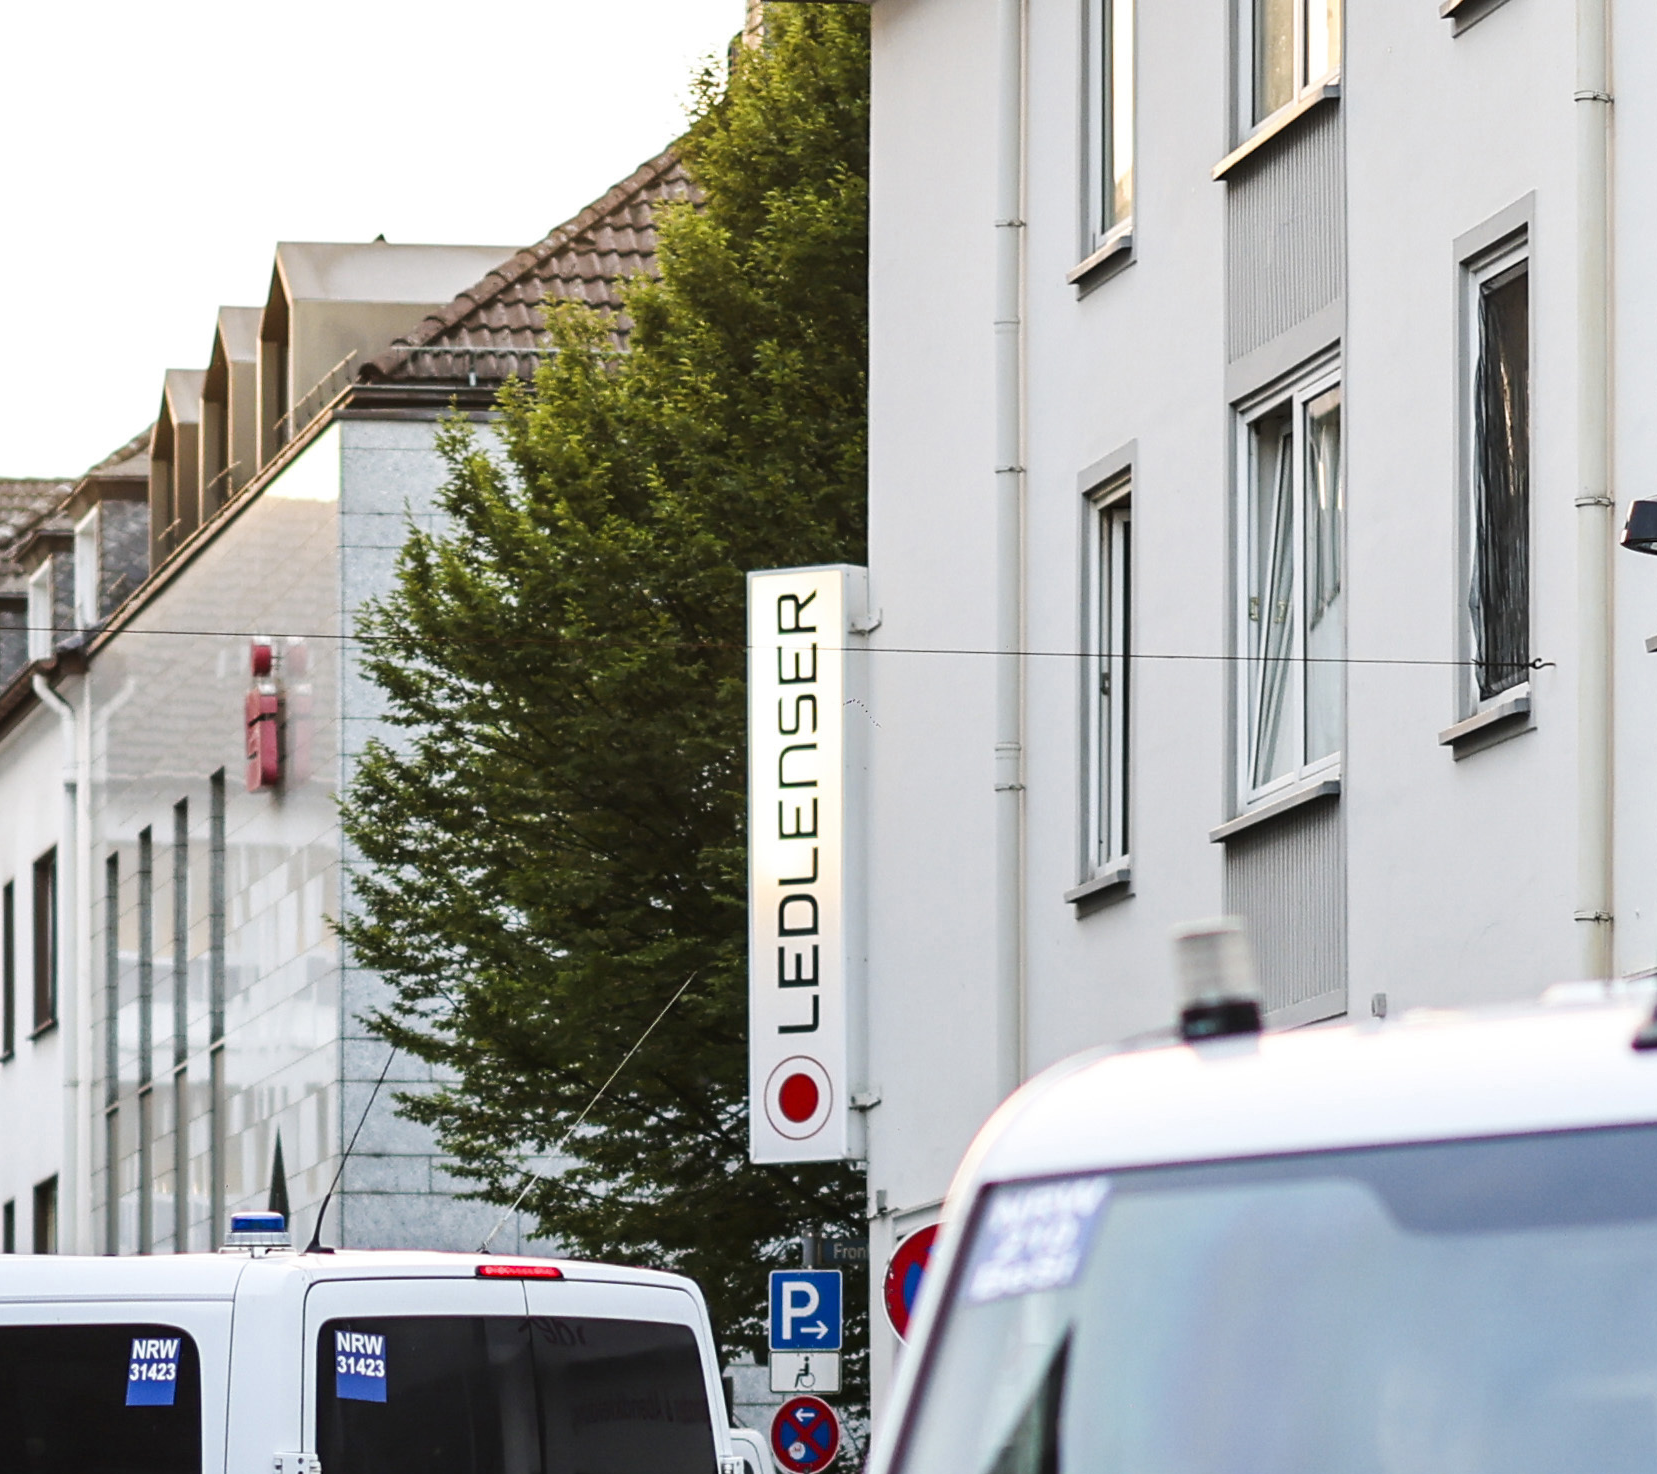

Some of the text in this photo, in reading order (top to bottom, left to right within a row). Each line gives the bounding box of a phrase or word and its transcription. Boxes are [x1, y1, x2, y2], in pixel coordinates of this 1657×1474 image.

[777, 588, 821, 1035] LEDLENSER
[132, 1339, 179, 1360] NRW
[337, 1334, 384, 1356] NRW
[129, 1362, 177, 1381] 31423
[337, 1355, 385, 1378] 31423
